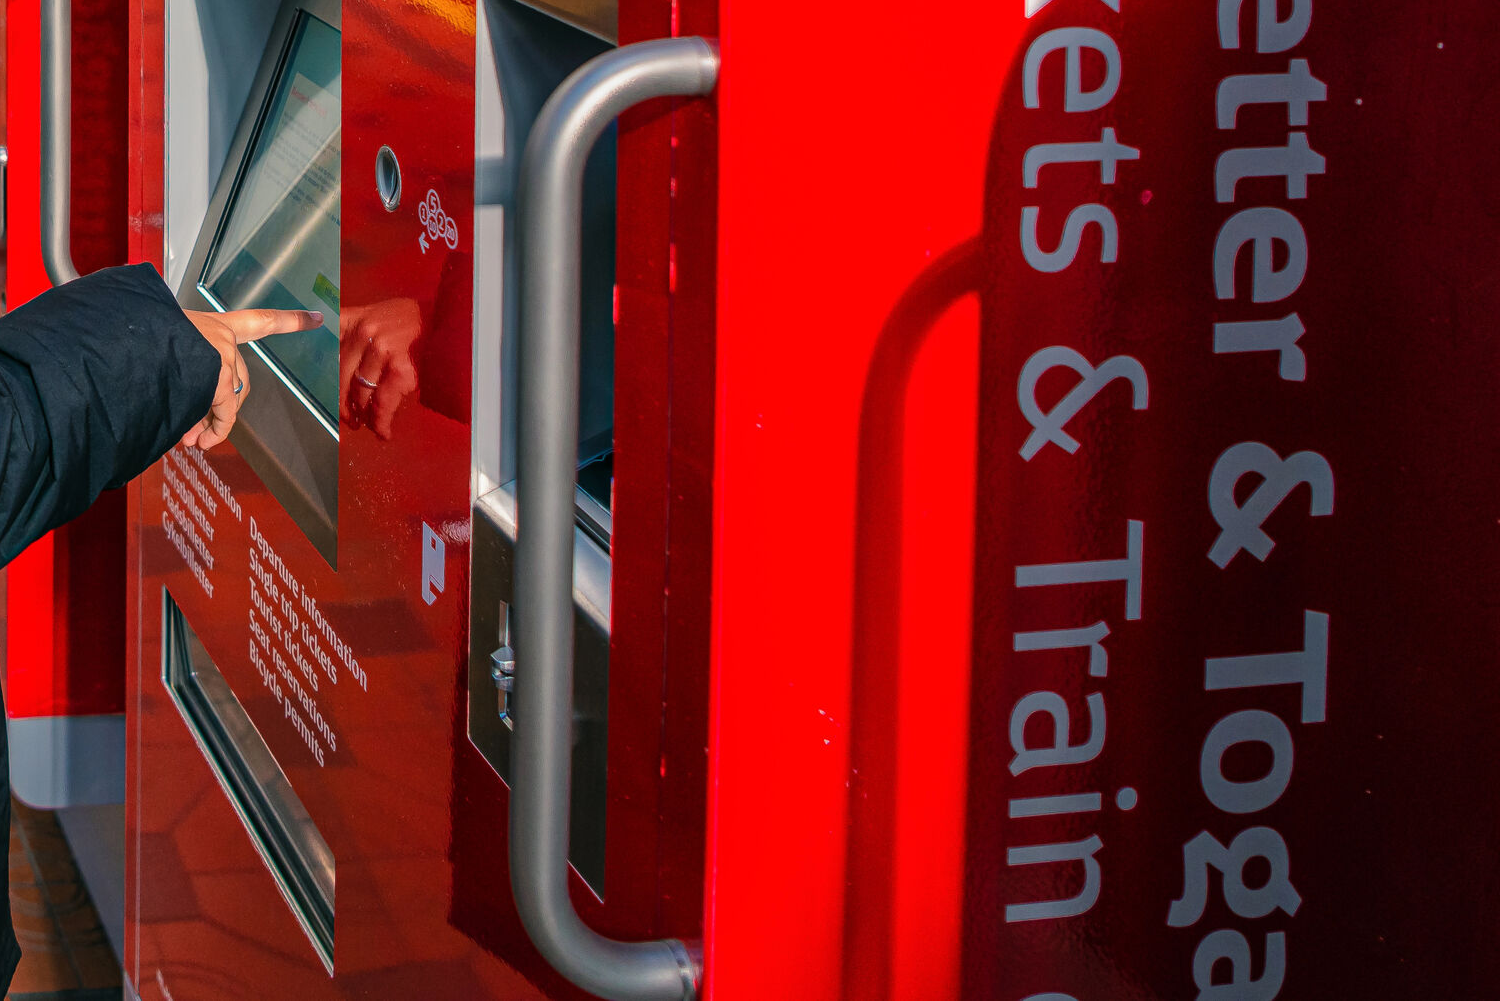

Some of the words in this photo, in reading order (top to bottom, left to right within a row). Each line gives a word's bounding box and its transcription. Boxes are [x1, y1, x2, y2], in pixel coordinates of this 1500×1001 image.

[1016, 345, 1150, 462] &
[162, 510, 214, 599] Cykelbilletter
[1206, 441, 1335, 570] &
[249, 515, 299, 599] Departure
[301, 584, 368, 692] information
[249, 547, 279, 604] Single
[281, 593, 299, 633] trip
[301, 621, 338, 685] tickets
[249, 576, 282, 641] Tourist
[284, 629, 319, 692] tickets
[249, 608, 271, 656] Seat
[272, 646, 337, 752] reservations
[249, 638, 283, 704] Bicycle
[284, 696, 325, 768] permits
[1004, 519, 1145, 924] Train
